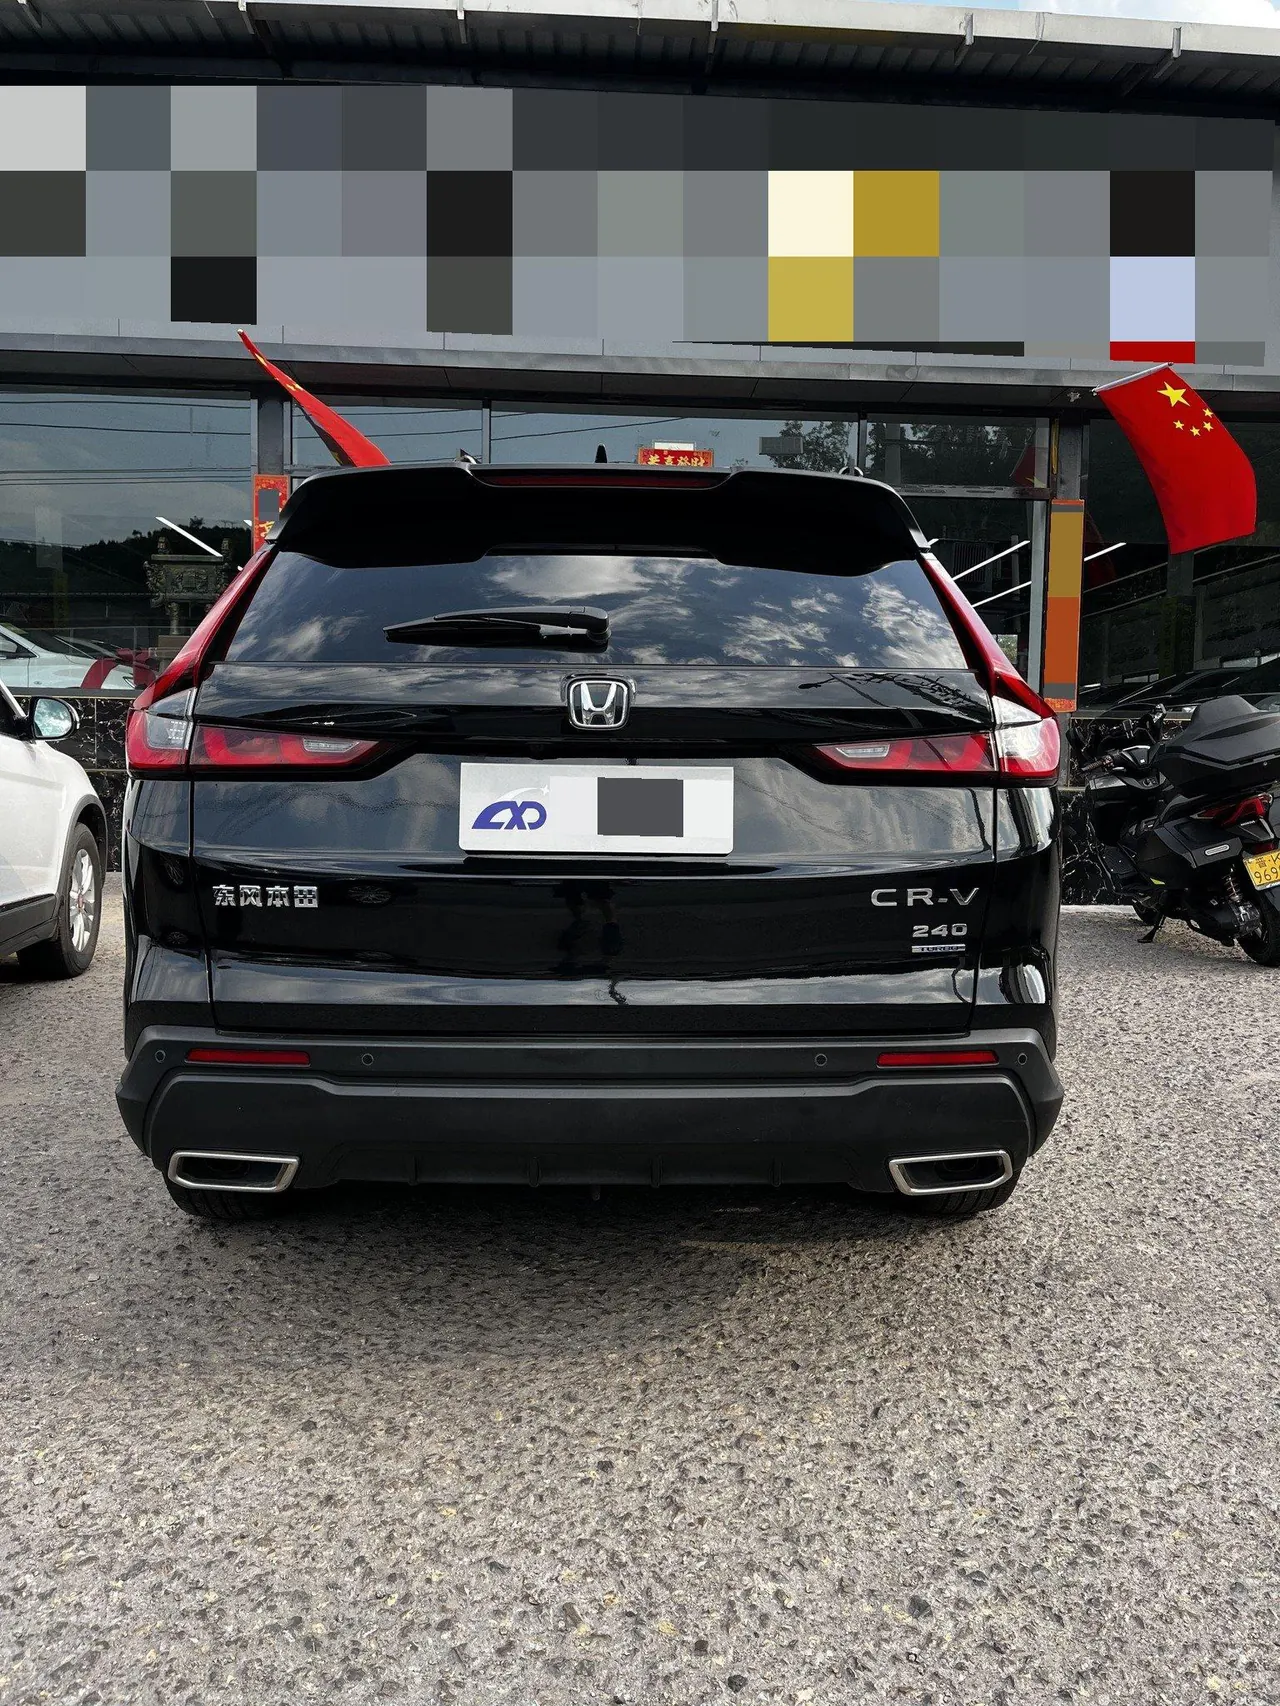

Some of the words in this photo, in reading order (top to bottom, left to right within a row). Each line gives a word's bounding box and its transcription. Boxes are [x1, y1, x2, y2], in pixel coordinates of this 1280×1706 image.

[1254, 866, 1280, 883] 969
[212, 884, 318, 908] 东风本田
[912, 923, 968, 938] 240
